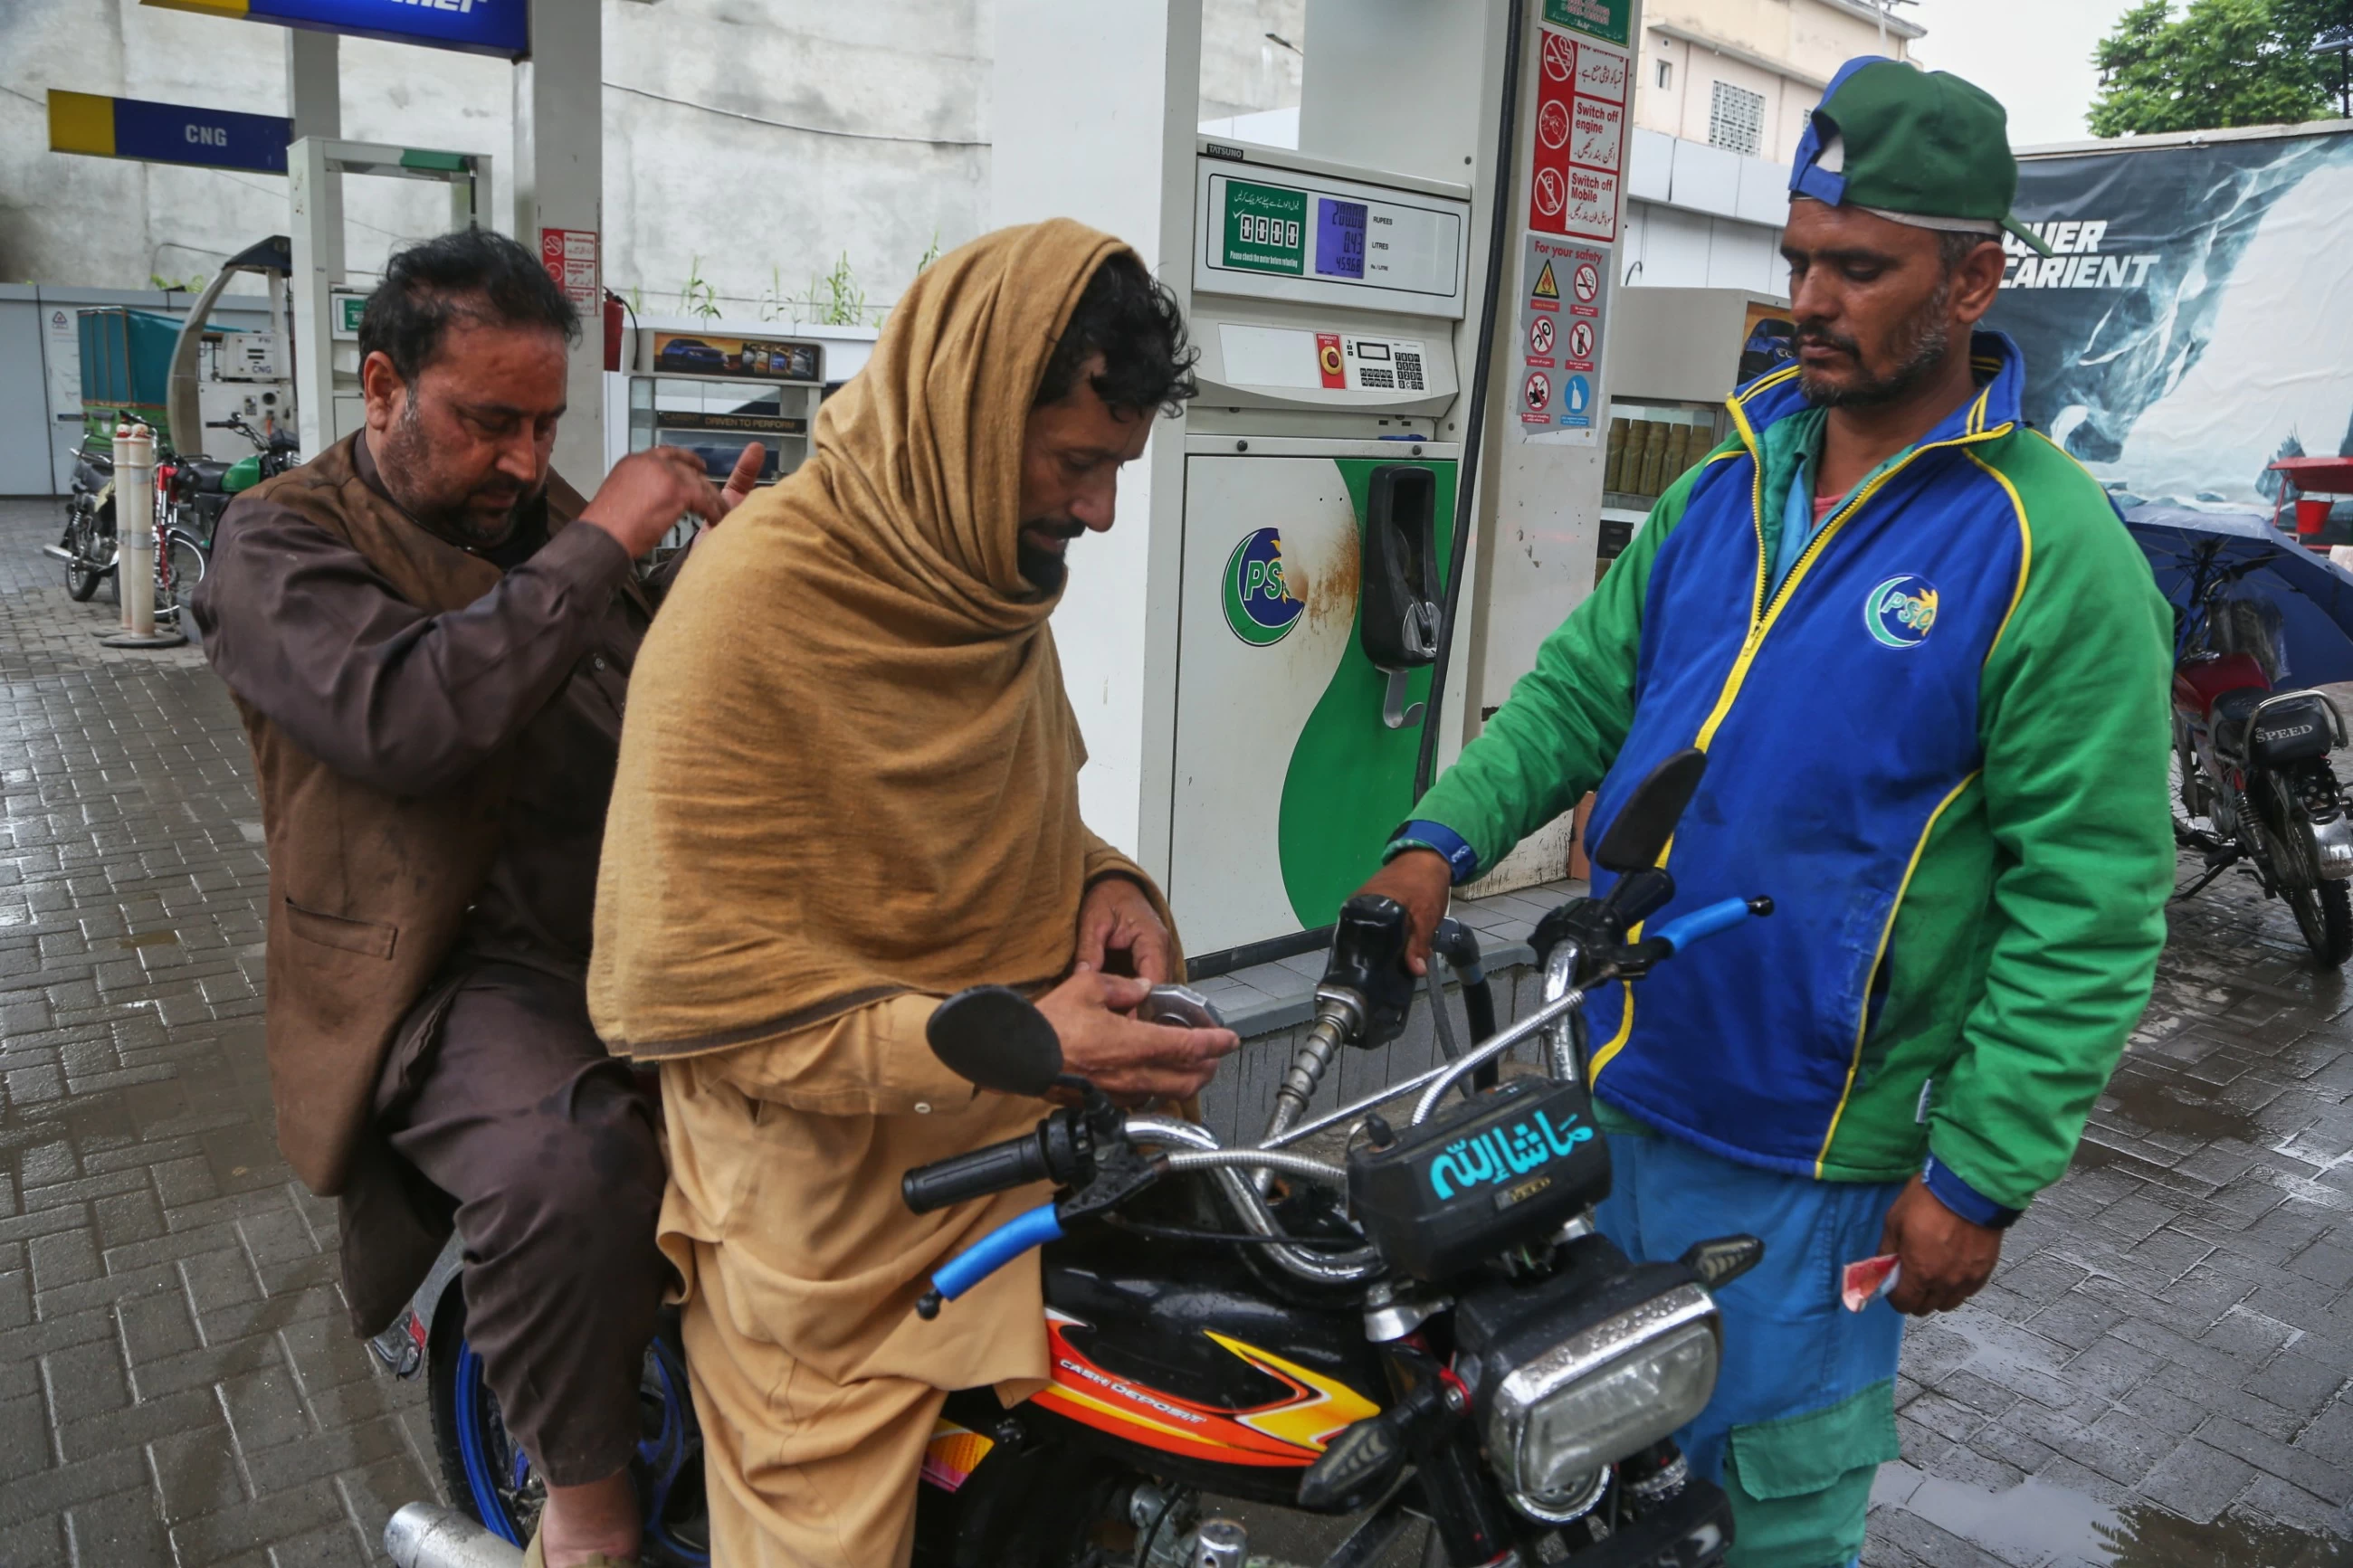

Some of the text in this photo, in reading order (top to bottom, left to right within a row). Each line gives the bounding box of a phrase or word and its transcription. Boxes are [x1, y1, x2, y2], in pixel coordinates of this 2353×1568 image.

[1577, 101, 1618, 123] Switch off
[186, 125, 227, 147] CNG
[1576, 119, 1603, 134] engine
[1209, 145, 1242, 157] TATSUNO
[1572, 173, 1613, 192] Switch off
[1571, 186, 1597, 203] Mobile
[1373, 216, 1393, 225] RUPEES
[1372, 242, 1388, 250] LITRES
[1535, 241, 1603, 266] For your safety
[1998, 255, 2161, 290] CARIENT
[252, 365, 272, 375] CNG
[705, 416, 738, 426] DRIVEN
[738, 418, 752, 427] TO
[753, 420, 795, 429] PERFORM
[1881, 592, 1935, 630] PSO
[2255, 724, 2313, 743] SPEED
[1059, 1357, 1207, 1424] CASH DEPOSIT
